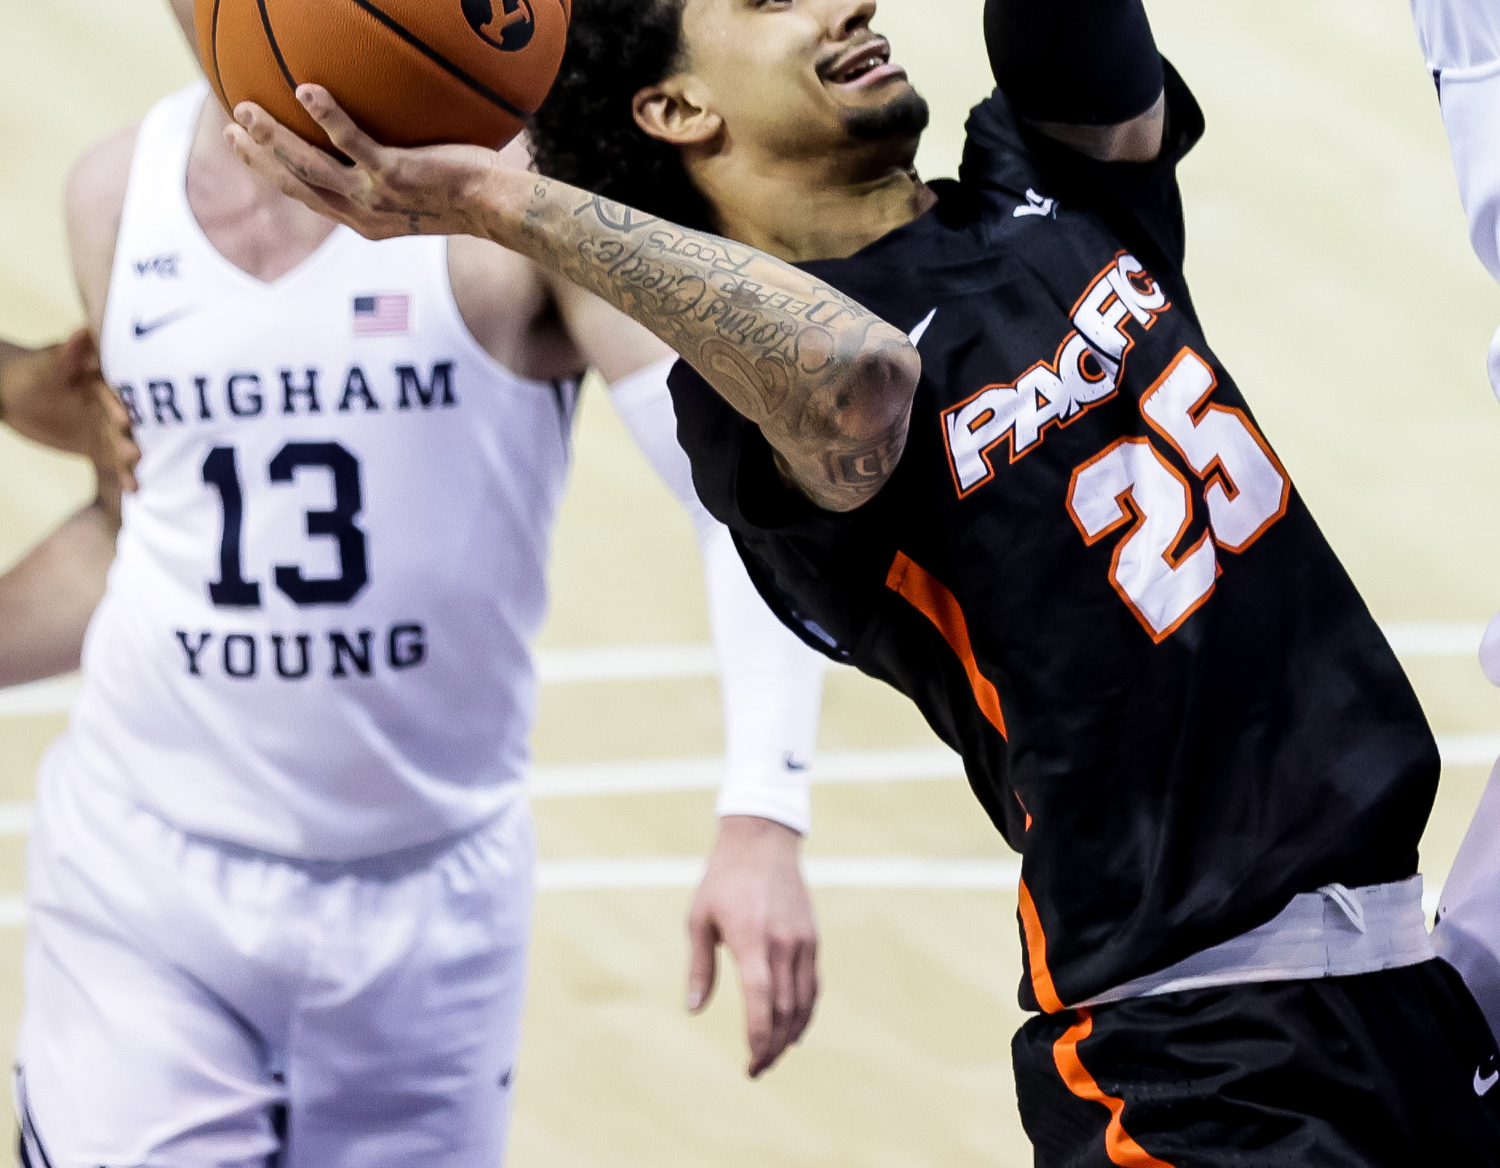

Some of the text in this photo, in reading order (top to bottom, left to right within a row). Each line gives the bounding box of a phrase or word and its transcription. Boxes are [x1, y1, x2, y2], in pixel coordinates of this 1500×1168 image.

[202, 442, 368, 608] 13
[1066, 346, 1291, 644] 25
[175, 622, 428, 680] YOUNG
